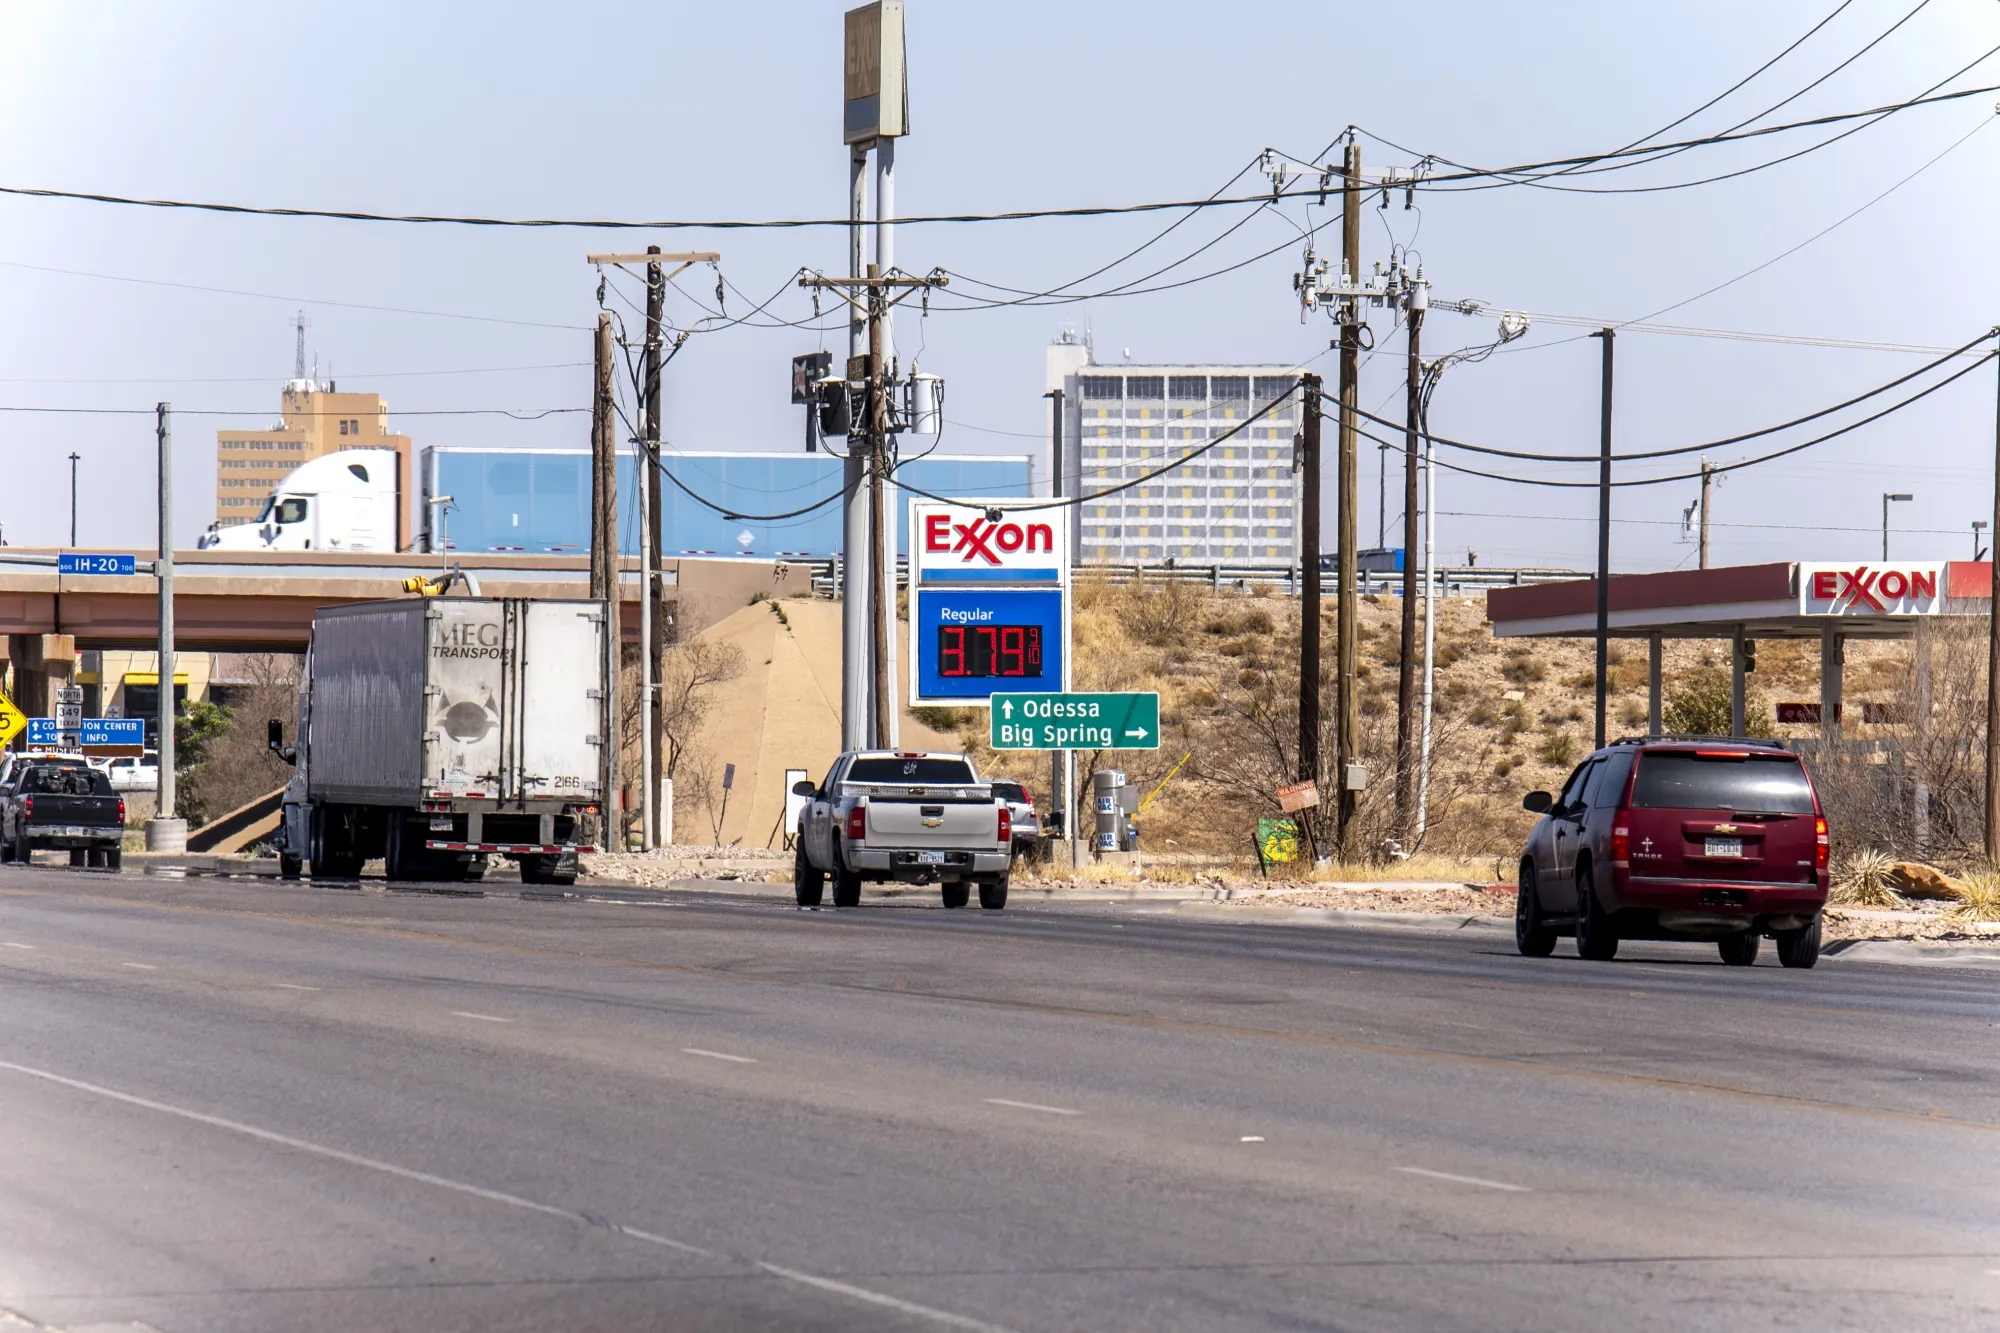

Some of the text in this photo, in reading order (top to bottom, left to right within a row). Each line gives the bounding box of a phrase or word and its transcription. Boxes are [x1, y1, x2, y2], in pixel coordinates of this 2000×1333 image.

[925, 514, 1053, 566] Exxon
[75, 558, 118, 572] IH-20
[1812, 566, 1937, 612] EXXON
[941, 607, 994, 624] Regular
[942, 627, 1024, 676] 3.79
[57, 690, 81, 699] NORTH
[58, 707, 80, 717] 349
[1023, 699, 1100, 718] Odessa
[104, 722, 137, 731] CENTER
[86, 733, 108, 742] INFO
[1001, 724, 1112, 747] Big Spring
[554, 776, 580, 788] 2166
[1278, 781, 1315, 796] WARNING
